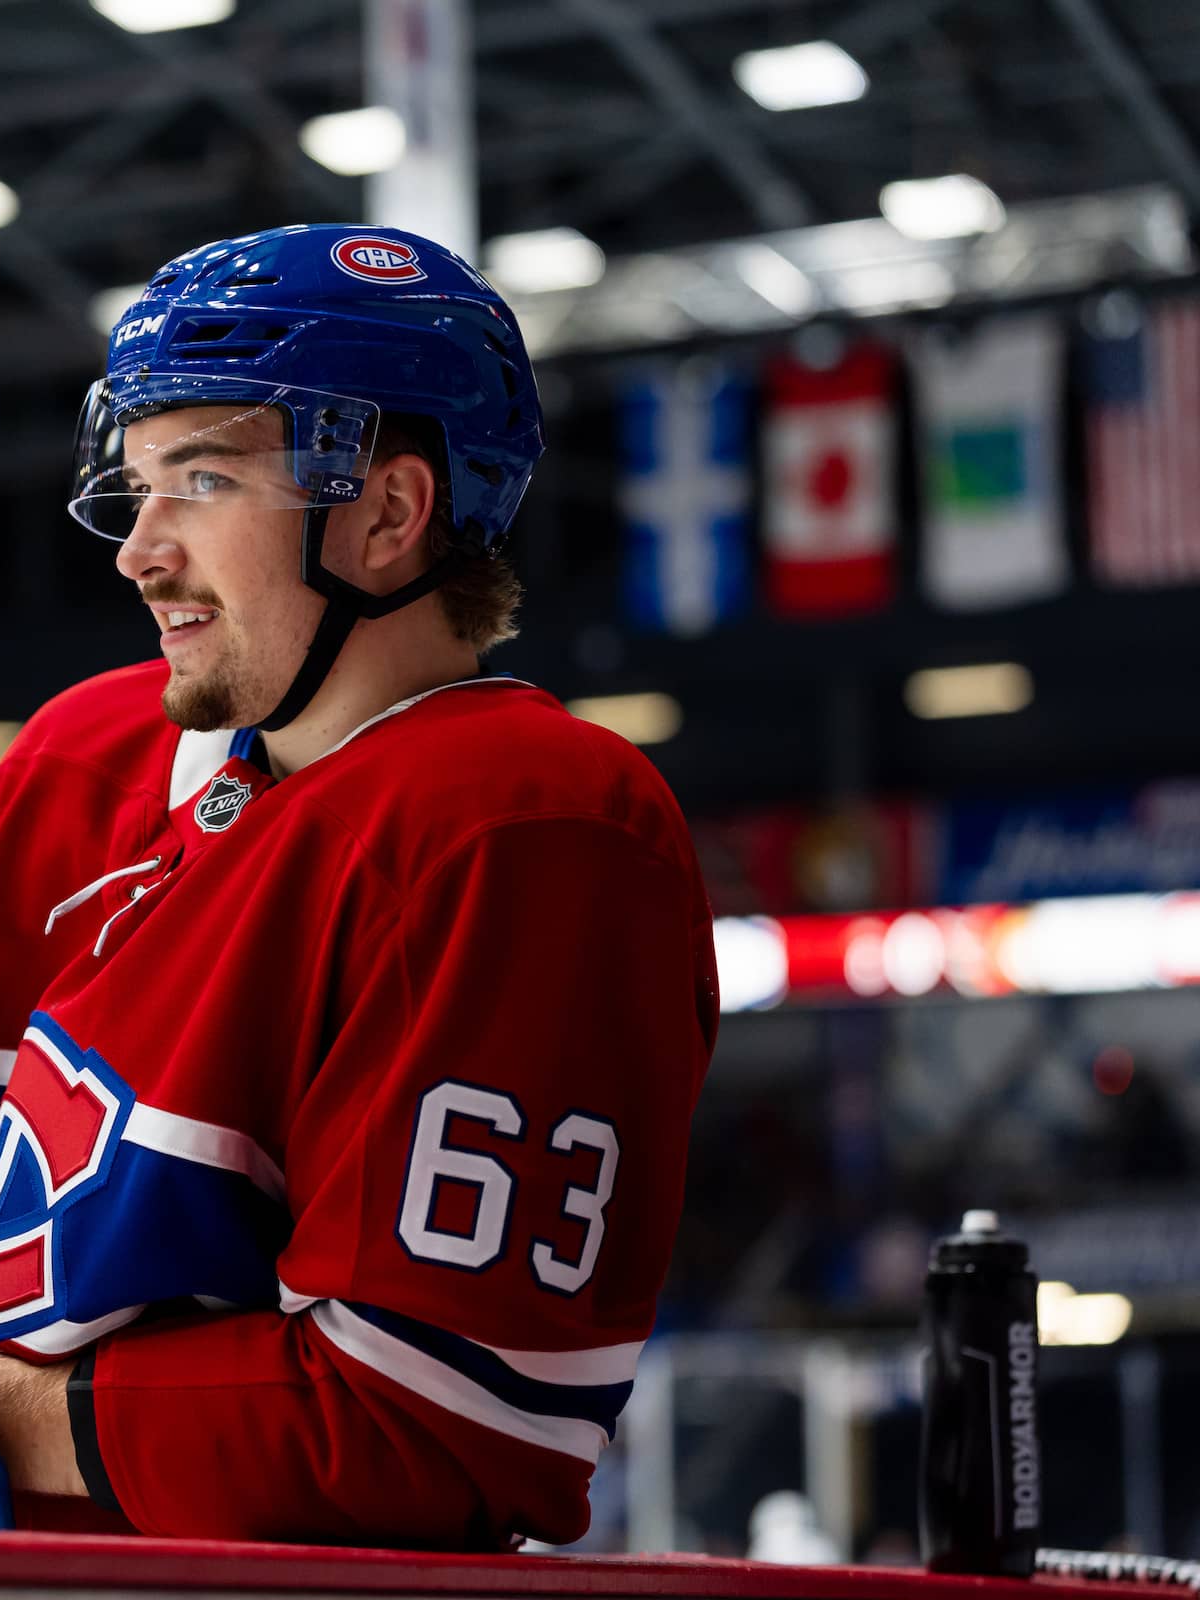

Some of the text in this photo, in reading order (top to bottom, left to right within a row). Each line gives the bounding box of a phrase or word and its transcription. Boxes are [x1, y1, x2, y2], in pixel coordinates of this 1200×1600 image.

[114, 313, 167, 348] CCM
[202, 793, 243, 816] LNH
[394, 1076, 621, 1298] 63
[1008, 1321, 1039, 1529] BODYARMOR
